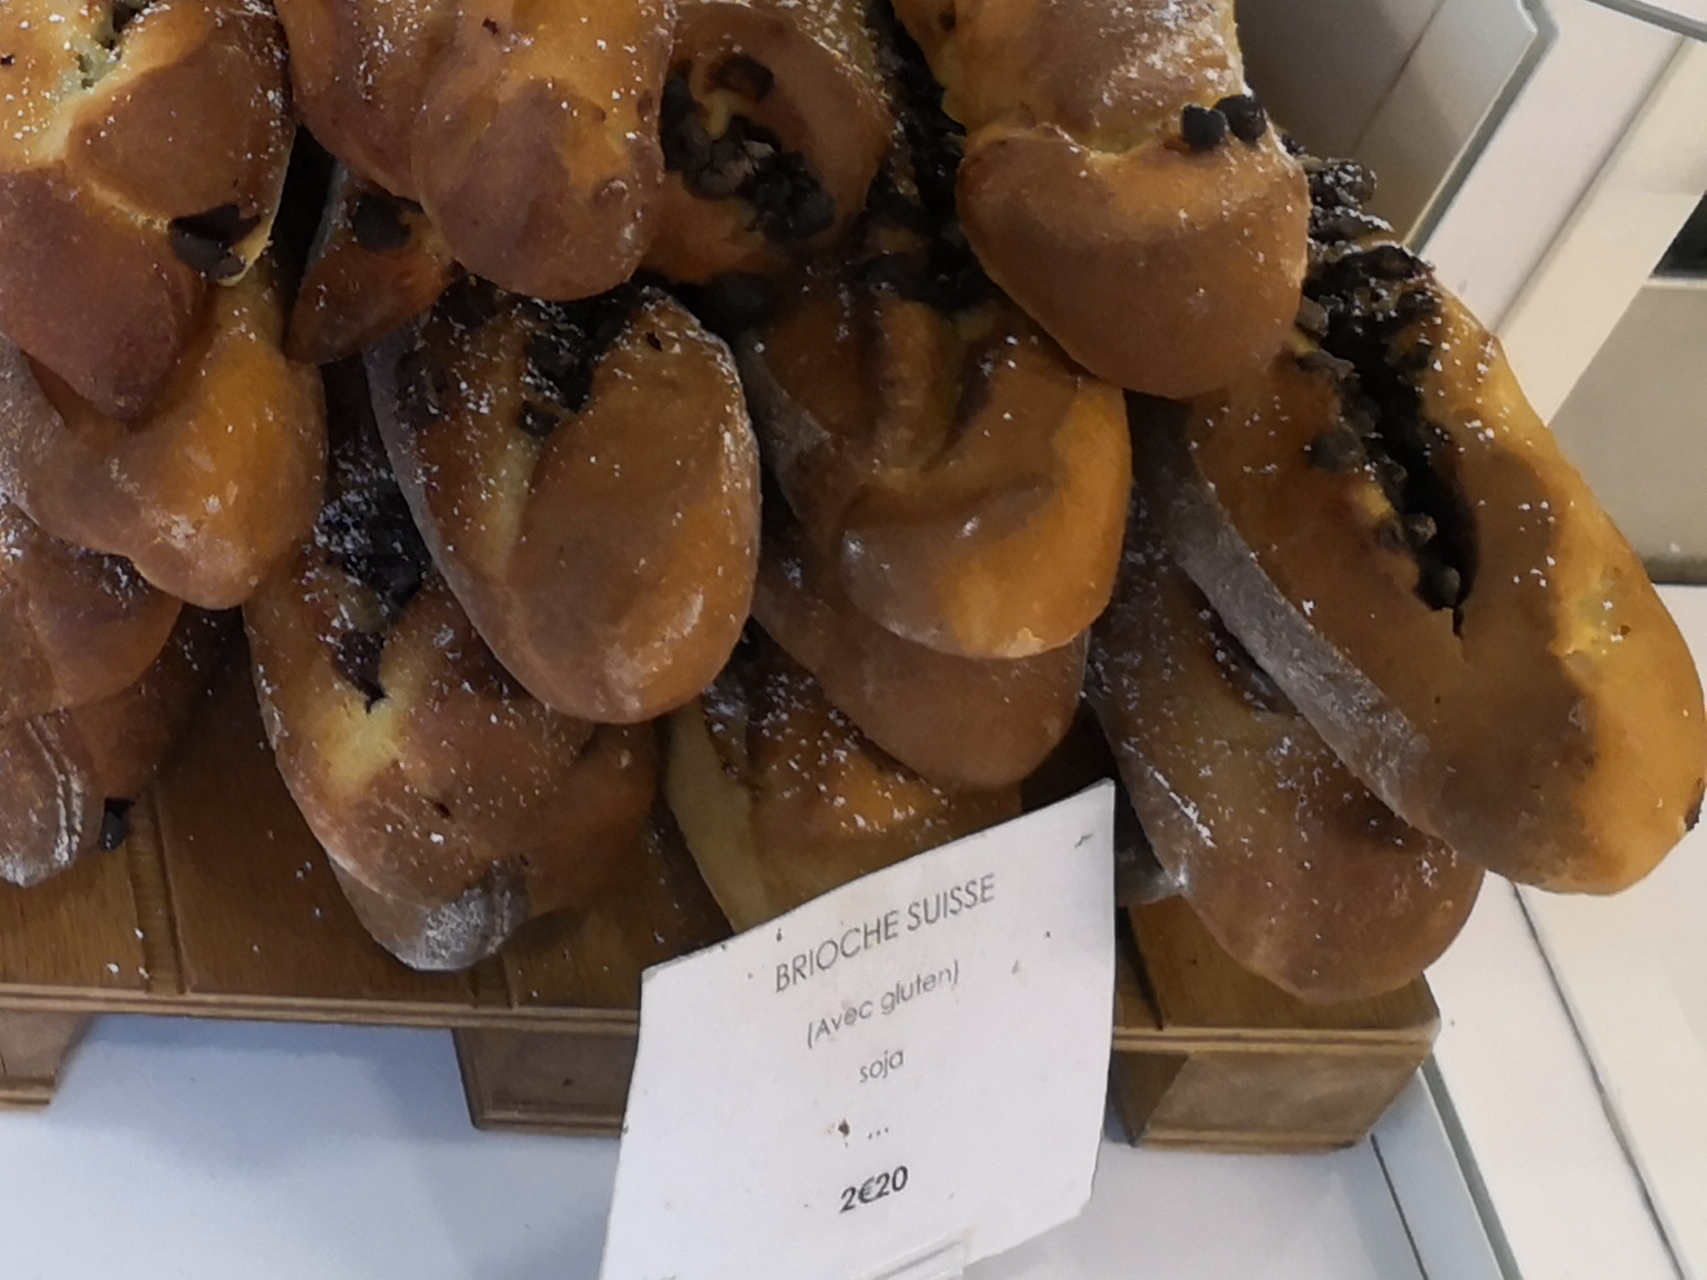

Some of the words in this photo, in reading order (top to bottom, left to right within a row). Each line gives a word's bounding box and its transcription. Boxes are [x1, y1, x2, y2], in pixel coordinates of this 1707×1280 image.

[774, 910, 899, 994] BRIOCHE
[906, 873, 996, 933] SUISSE
[806, 995, 873, 1049] (Avec
[879, 959, 961, 1015] gluten)
[858, 1048, 905, 1084] soja
[839, 1165, 909, 1214] 2€20
